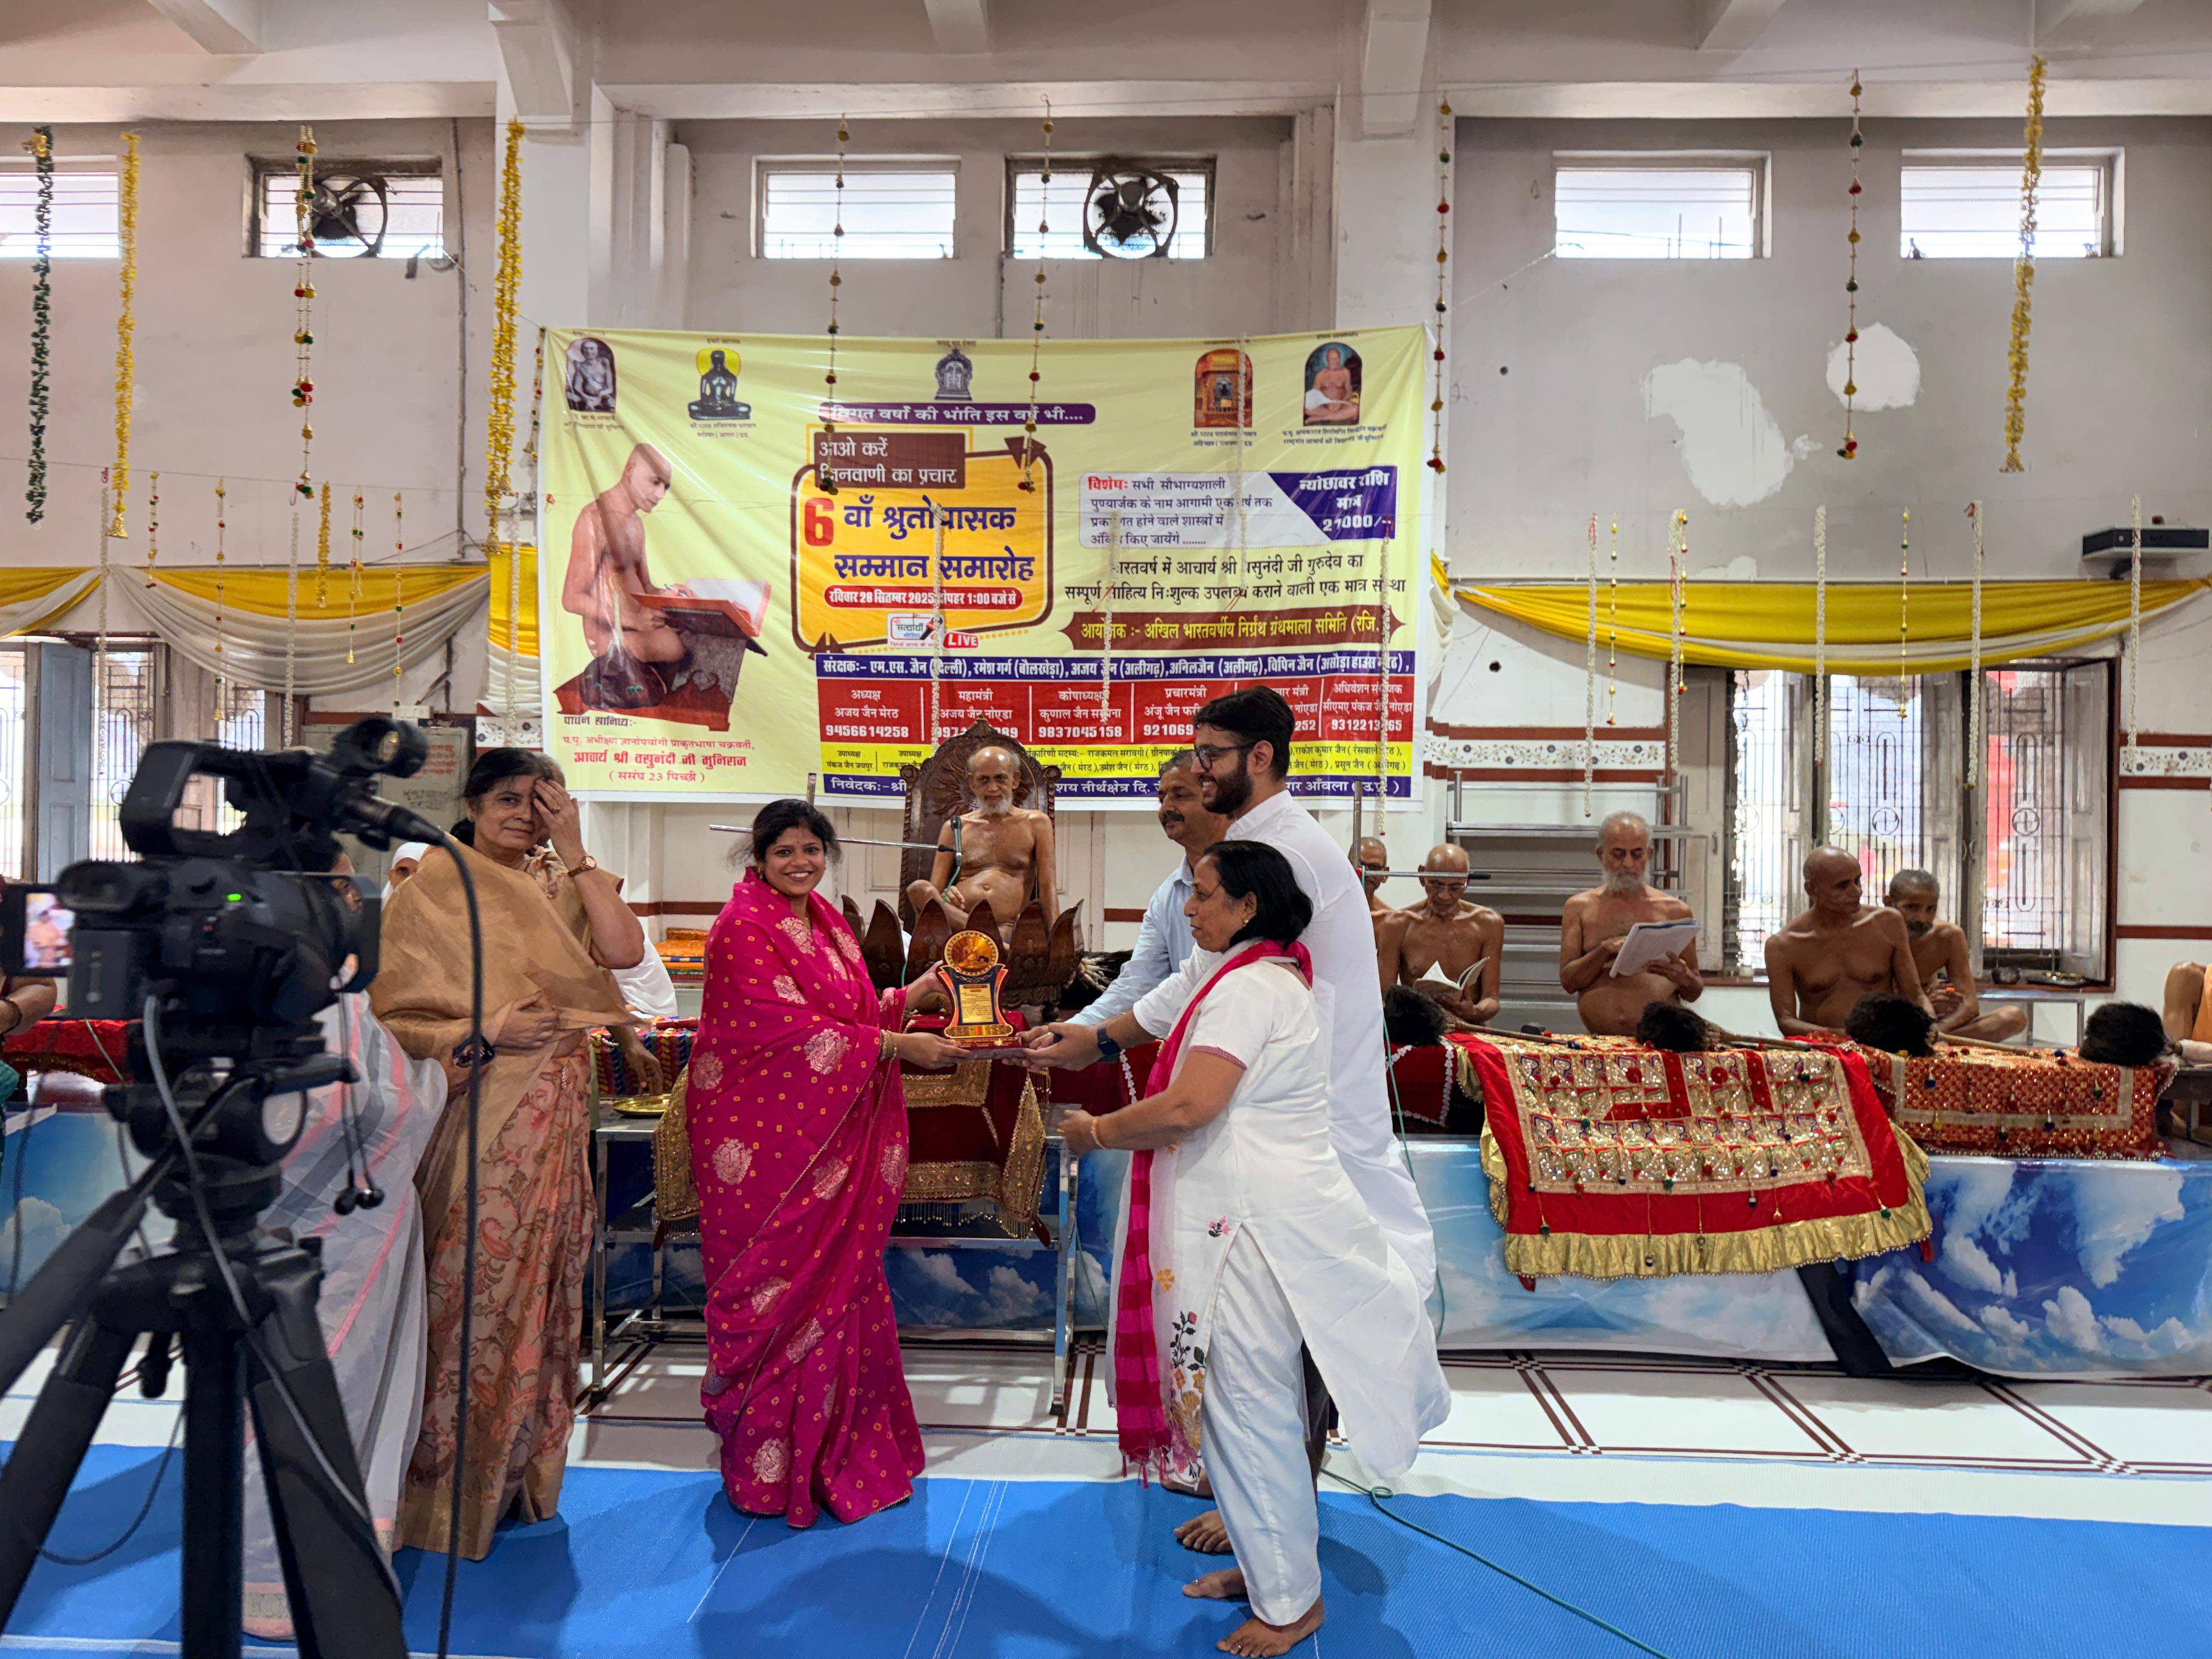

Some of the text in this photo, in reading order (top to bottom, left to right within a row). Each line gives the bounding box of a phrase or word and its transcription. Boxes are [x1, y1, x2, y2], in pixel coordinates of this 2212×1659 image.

[878, 405, 911, 420] वर्षों
[915, 406, 938, 420] की
[943, 407, 981, 421] भांति
[986, 410, 1009, 422] इस
[819, 436, 888, 456] आओ करें
[891, 469, 913, 482] का
[918, 469, 957, 485] प्रचार
[1132, 477, 1154, 490] सभी
[1160, 477, 1226, 490] सौभाग्यशाली
[1299, 469, 1390, 491] न्योछावर राशि
[1090, 495, 1273, 512] पुण्यार्जक के नाम आगामी एक तक
[1336, 494, 1362, 510] मात्र
[804, 498, 834, 546] 6
[844, 494, 873, 528] वाँ
[1136, 513, 1224, 527] होने वाले शास्त्रों में
[1125, 532, 1149, 546] किए
[834, 545, 1035, 582] सम्मान समारोह
[1162, 556, 1172, 574] में
[1177, 556, 1217, 574] आचार्य
[1221, 556, 1237, 574] श्री
[1288, 554, 1303, 573] जी
[1308, 551, 1342, 575] गुरुदेव
[1347, 555, 1364, 568] का
[829, 588, 859, 602] रविवार
[860, 591, 873, 603] 28
[874, 589, 907, 603] सितम्बर
[908, 592, 934, 604] 2025
[967, 593, 990, 604] 1:00
[991, 590, 1007, 605] बजे
[1008, 590, 1016, 605] से
[1065, 580, 1102, 605] सम्पूर्ण
[1252, 580, 1282, 597] कराने
[1287, 576, 1315, 596] वाली
[1319, 581, 1340, 596] एक
[1345, 579, 1368, 592] मात्र
[1144, 617, 1180, 639] अखिल
[1183, 616, 1235, 639] भारतवर्षीय
[1270, 616, 1312, 636] ग्रंथमाला
[1315, 611, 1347, 634] समिति
[948, 634, 978, 646] LIVE
[870, 661, 908, 674] एम.एस.
[910, 658, 927, 674] जैन
[974, 659, 996, 675] रमेश
[996, 659, 1012, 675] गर्ग
[1071, 663, 1097, 675] अजय
[1268, 656, 1295, 672] विपिन
[1297, 654, 1314, 672] जैन
[1164, 685, 1207, 698] प्रचारमंत्री
[1291, 684, 1309, 697] मंत्री
[1334, 680, 1369, 694] अधिवेशन
[851, 690, 882, 702] अध्यक्ष
[957, 688, 994, 702] महामंत्री
[1058, 687, 1104, 702] कोषाध्यक्ष
[834, 704, 899, 718] अजय जैन मेरठ
[1144, 703, 1180, 720] अंजू जैन
[1294, 701, 1318, 715] नोएडा
[1323, 698, 1413, 715] सीएमए पंकज नोएडा
[940, 709, 965, 719] अजय
[984, 706, 1013, 722] नोएडा
[1039, 706, 1089, 723] कुणाल जैन
[826, 725, 909, 738] 9456614258
[1039, 726, 1122, 737] 9837045158
[670, 740, 715, 750] प्राकृतभाषा
[1120, 747, 1144, 757] सरावगी
[1295, 743, 1313, 754] राकेश
[1314, 746, 1333, 757] कुमार
[1334, 743, 1346, 753] जैन
[574, 749, 747, 770] आचार्य श्री वसुनंदी जी मुनिराज
[837, 751, 861, 759] उपाध्यक्ष
[898, 751, 922, 759] उपाध्यक्ष
[827, 760, 873, 771] पंकज जैन जयपुर
[1077, 761, 1092, 772] मेरठ
[1116, 761, 1128, 771] जैन
[1135, 761, 1148, 771] मेरठ
[1294, 758, 1304, 769] जैन
[1310, 758, 1323, 768] मेरठ
[1335, 760, 1351, 771] प्रसून
[1352, 758, 1364, 769] जैन
[617, 769, 697, 782] ससंघ 23 पिच्छी
[1081, 780, 1130, 794] तीर्थक्षेत्र
[1306, 777, 1349, 791] आँवला
